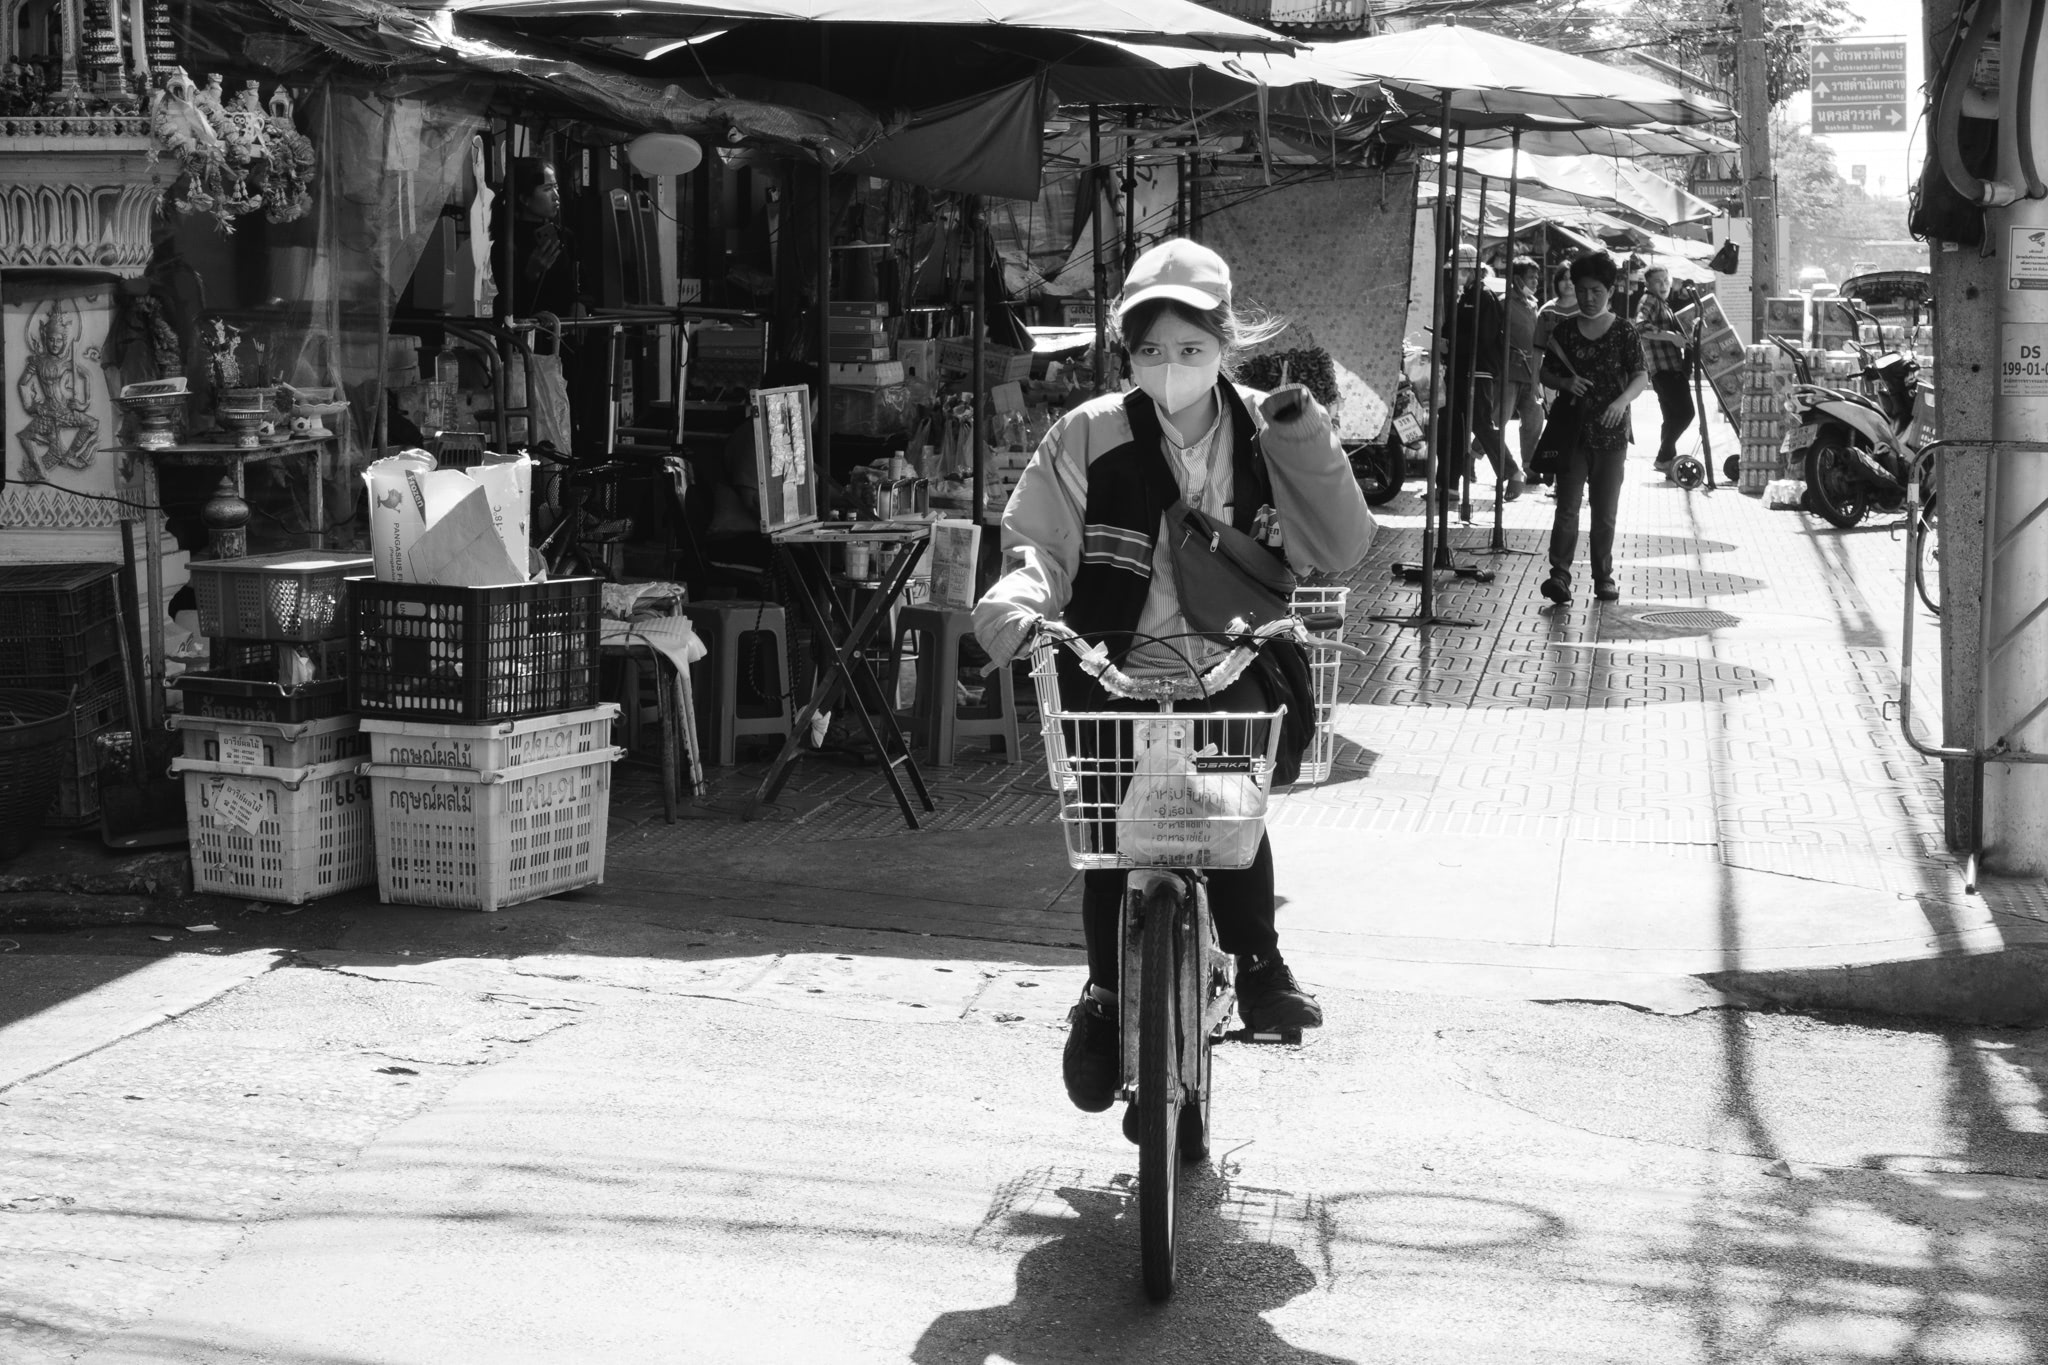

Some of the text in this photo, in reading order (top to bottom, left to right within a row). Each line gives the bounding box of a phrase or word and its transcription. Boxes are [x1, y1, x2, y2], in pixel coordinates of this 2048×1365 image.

[1831, 77, 1906, 91] ราชดำเนินกลาง
[1817, 105, 1882, 122] นครสวรรค์
[2020, 345, 2041, 359] DS
[408, 475, 424, 508] Frozen
[393, 522, 403, 571] PANGASIUS
[1197, 761, 1249, 769] OSAKA
[390, 784, 472, 814] กฤษณ์ผลไม้
